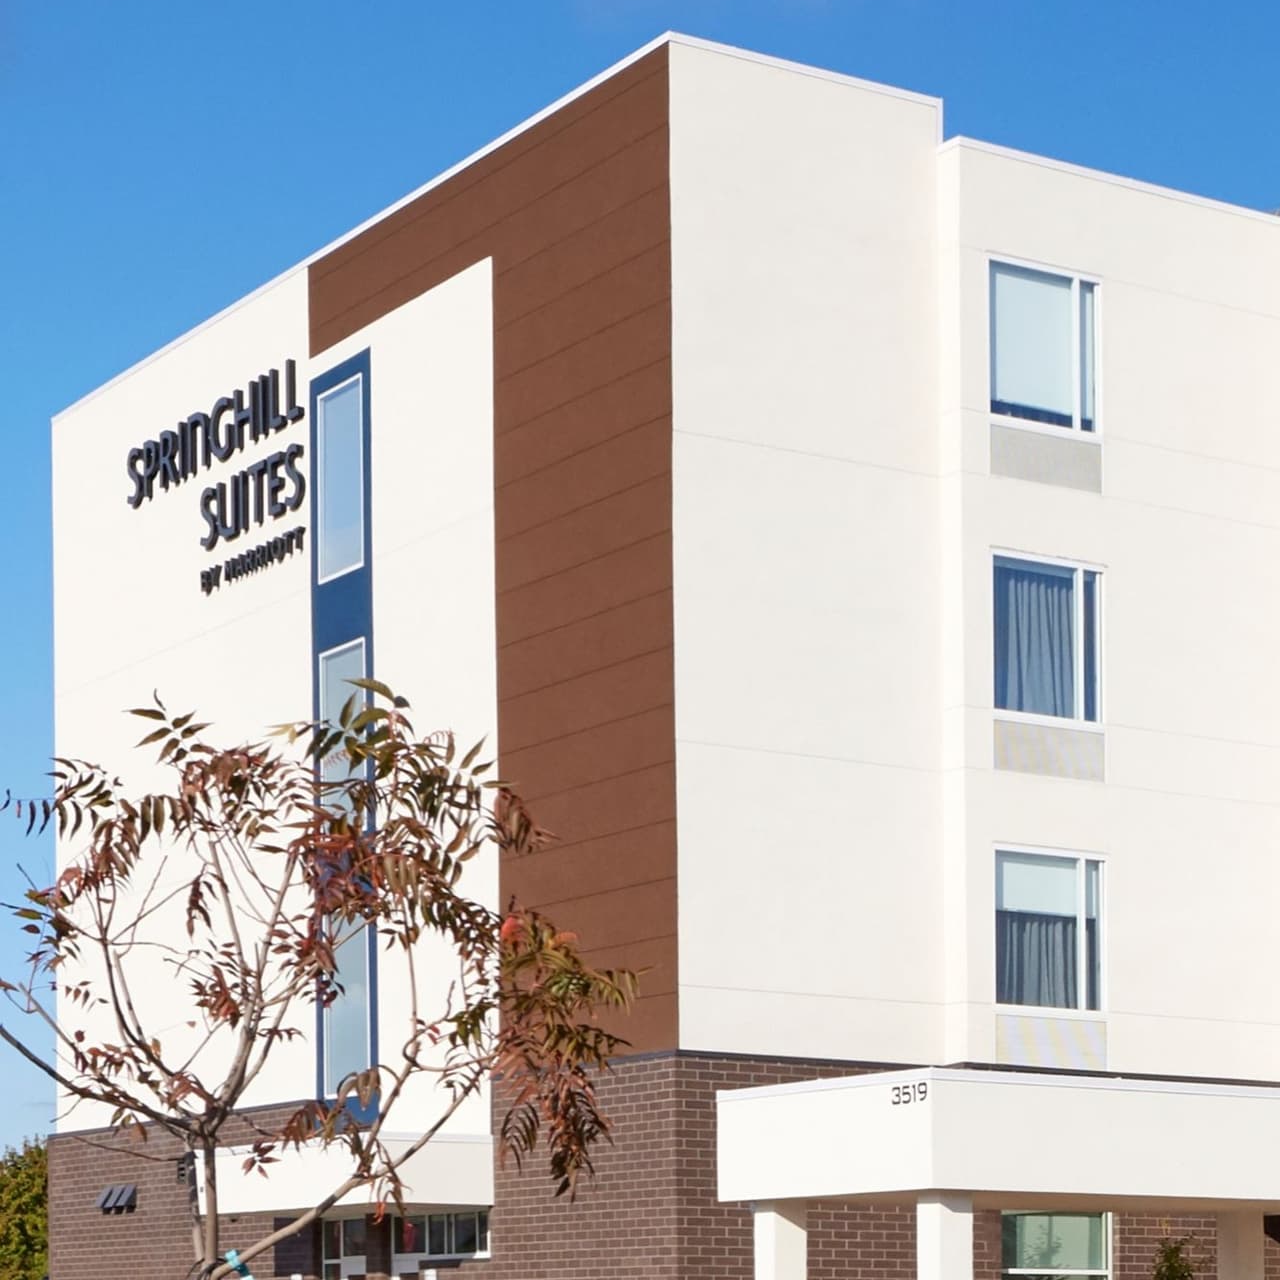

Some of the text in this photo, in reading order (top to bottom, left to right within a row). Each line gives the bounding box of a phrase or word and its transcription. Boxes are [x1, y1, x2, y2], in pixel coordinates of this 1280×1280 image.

[127, 359, 305, 508] SPRINGHILL
[200, 443, 306, 551] SUITES
[200, 526, 306, 595] BY MARRIOTT
[891, 1082, 928, 1105] 3519
